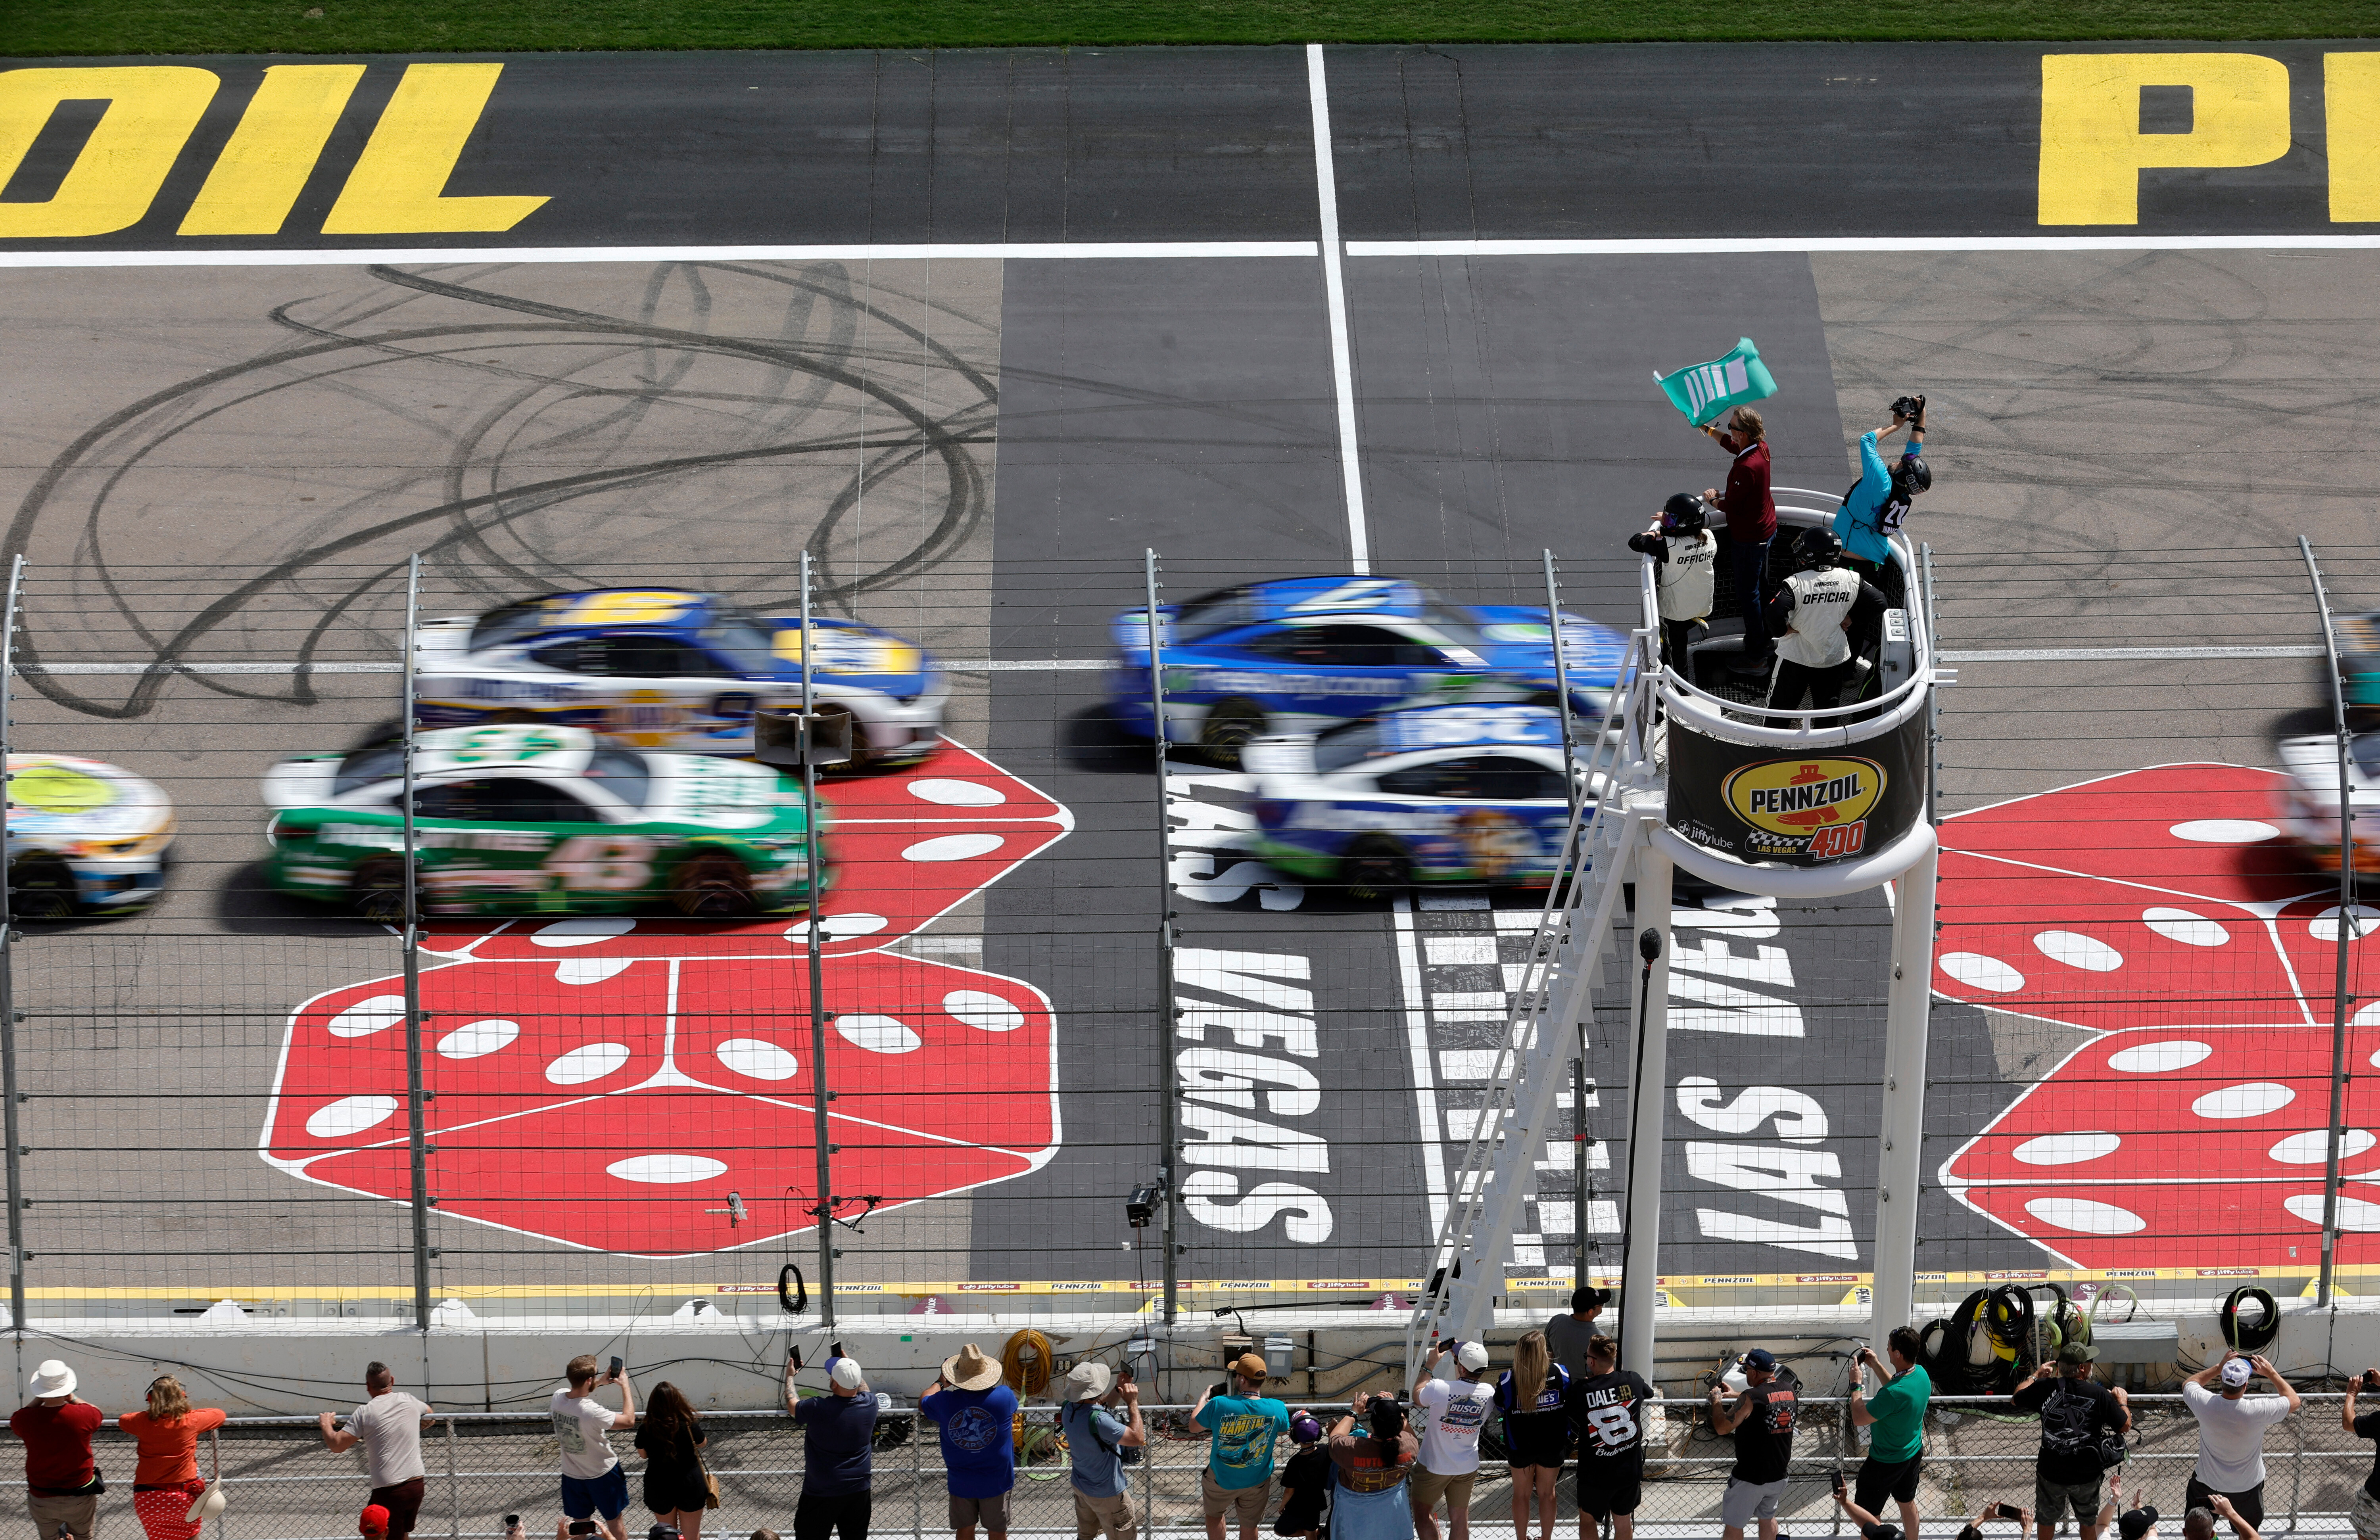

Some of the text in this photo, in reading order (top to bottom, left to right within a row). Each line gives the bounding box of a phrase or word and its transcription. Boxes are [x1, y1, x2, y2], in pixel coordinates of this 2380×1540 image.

[1885, 500, 1909, 526] 21
[1677, 550, 1713, 565] OFFICIAL
[1803, 592, 1850, 605] OFFICIAL
[1750, 771, 1863, 814] PENNZOIL
[1693, 819, 1710, 830] PRESENTED
[1808, 821, 1867, 858] 400
[1757, 845, 1771, 853] LAS
[1173, 946, 1334, 1244] VEGAS
[1676, 1076, 1859, 1260] LAS
[1586, 1388, 1618, 1408] DALE
[1449, 1404, 1484, 1414] BUSCH
[1587, 1405, 1637, 1446] 8
[958, 1431, 994, 1448] LARSON
[1595, 1440, 1638, 1457] Budweiser
